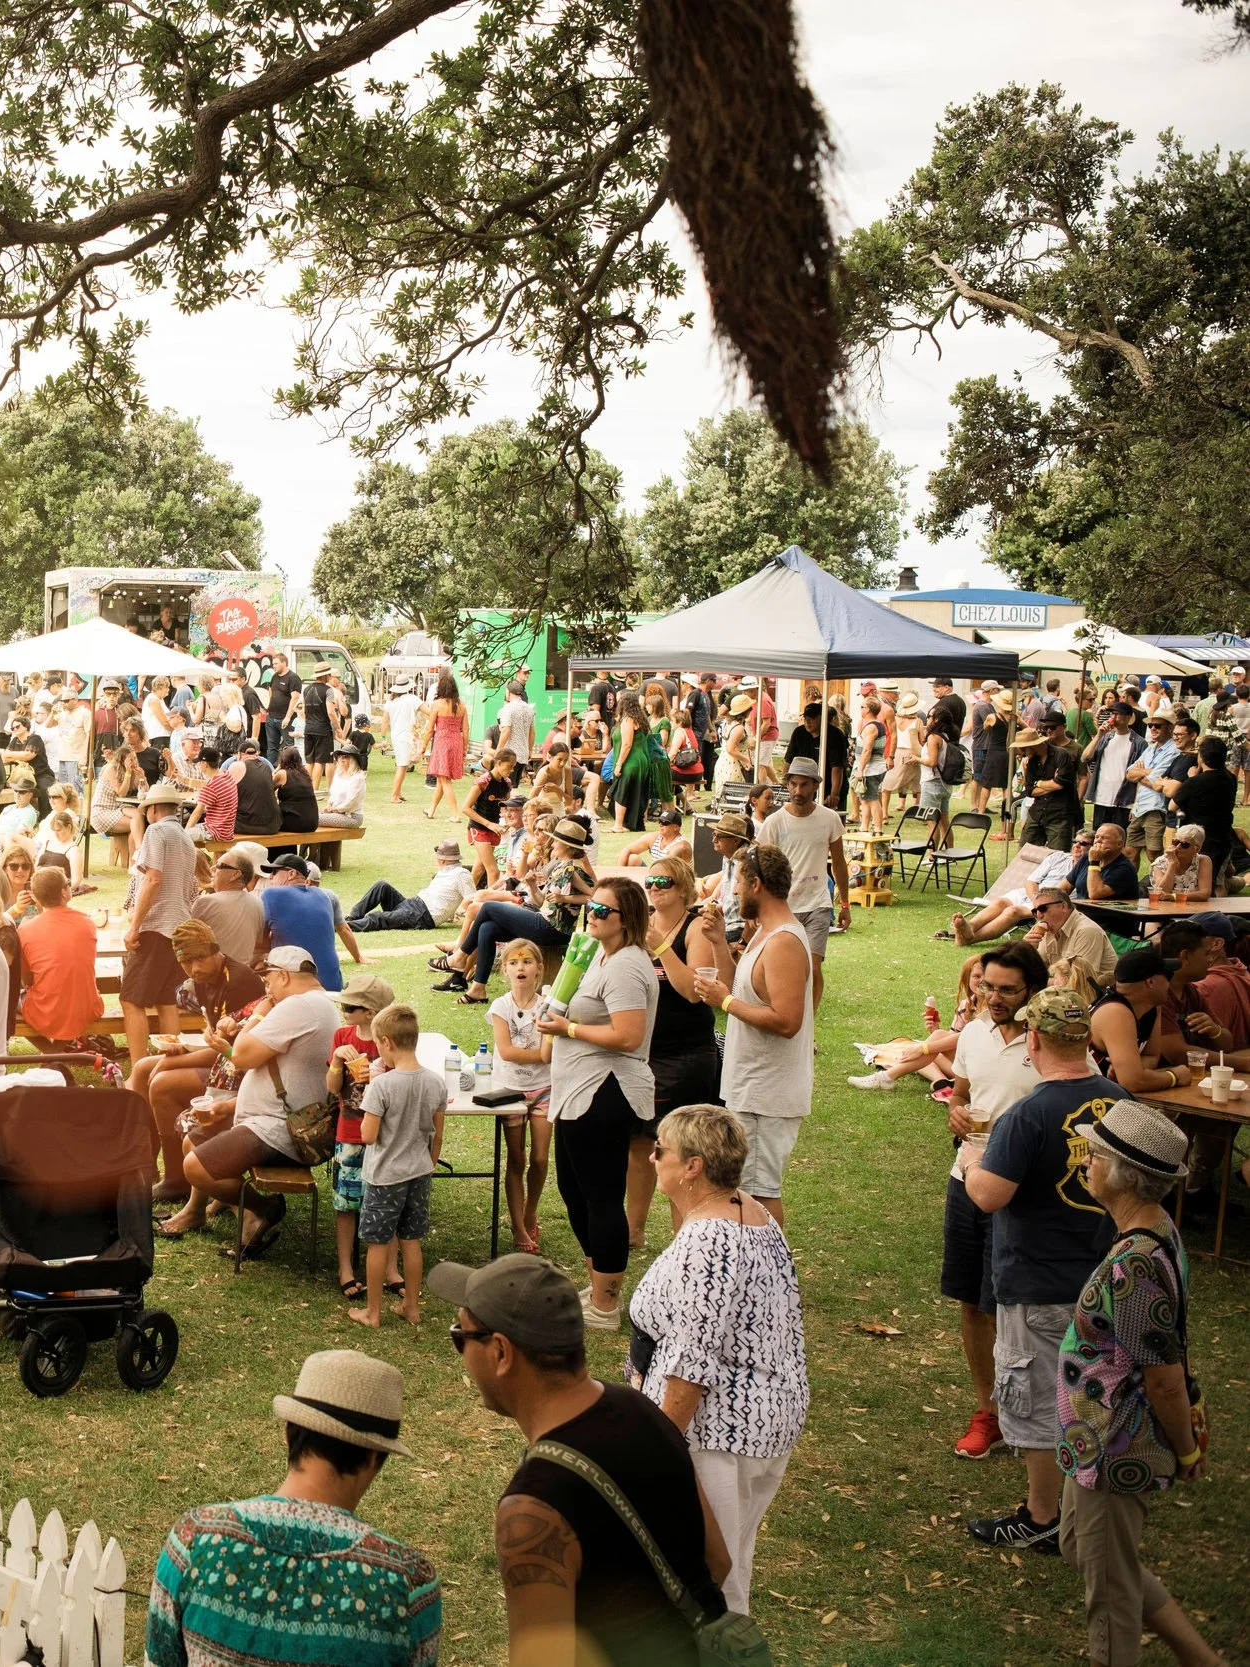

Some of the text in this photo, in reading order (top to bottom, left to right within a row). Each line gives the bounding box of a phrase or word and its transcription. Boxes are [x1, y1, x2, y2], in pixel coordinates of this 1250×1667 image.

[219, 608, 242, 622] TAG
[959, 605, 1041, 623] CHEZ LOUIS
[215, 616, 253, 635] BURGER
[1100, 673, 1118, 682] HVB
[593, 1472, 648, 1541] LOWER
